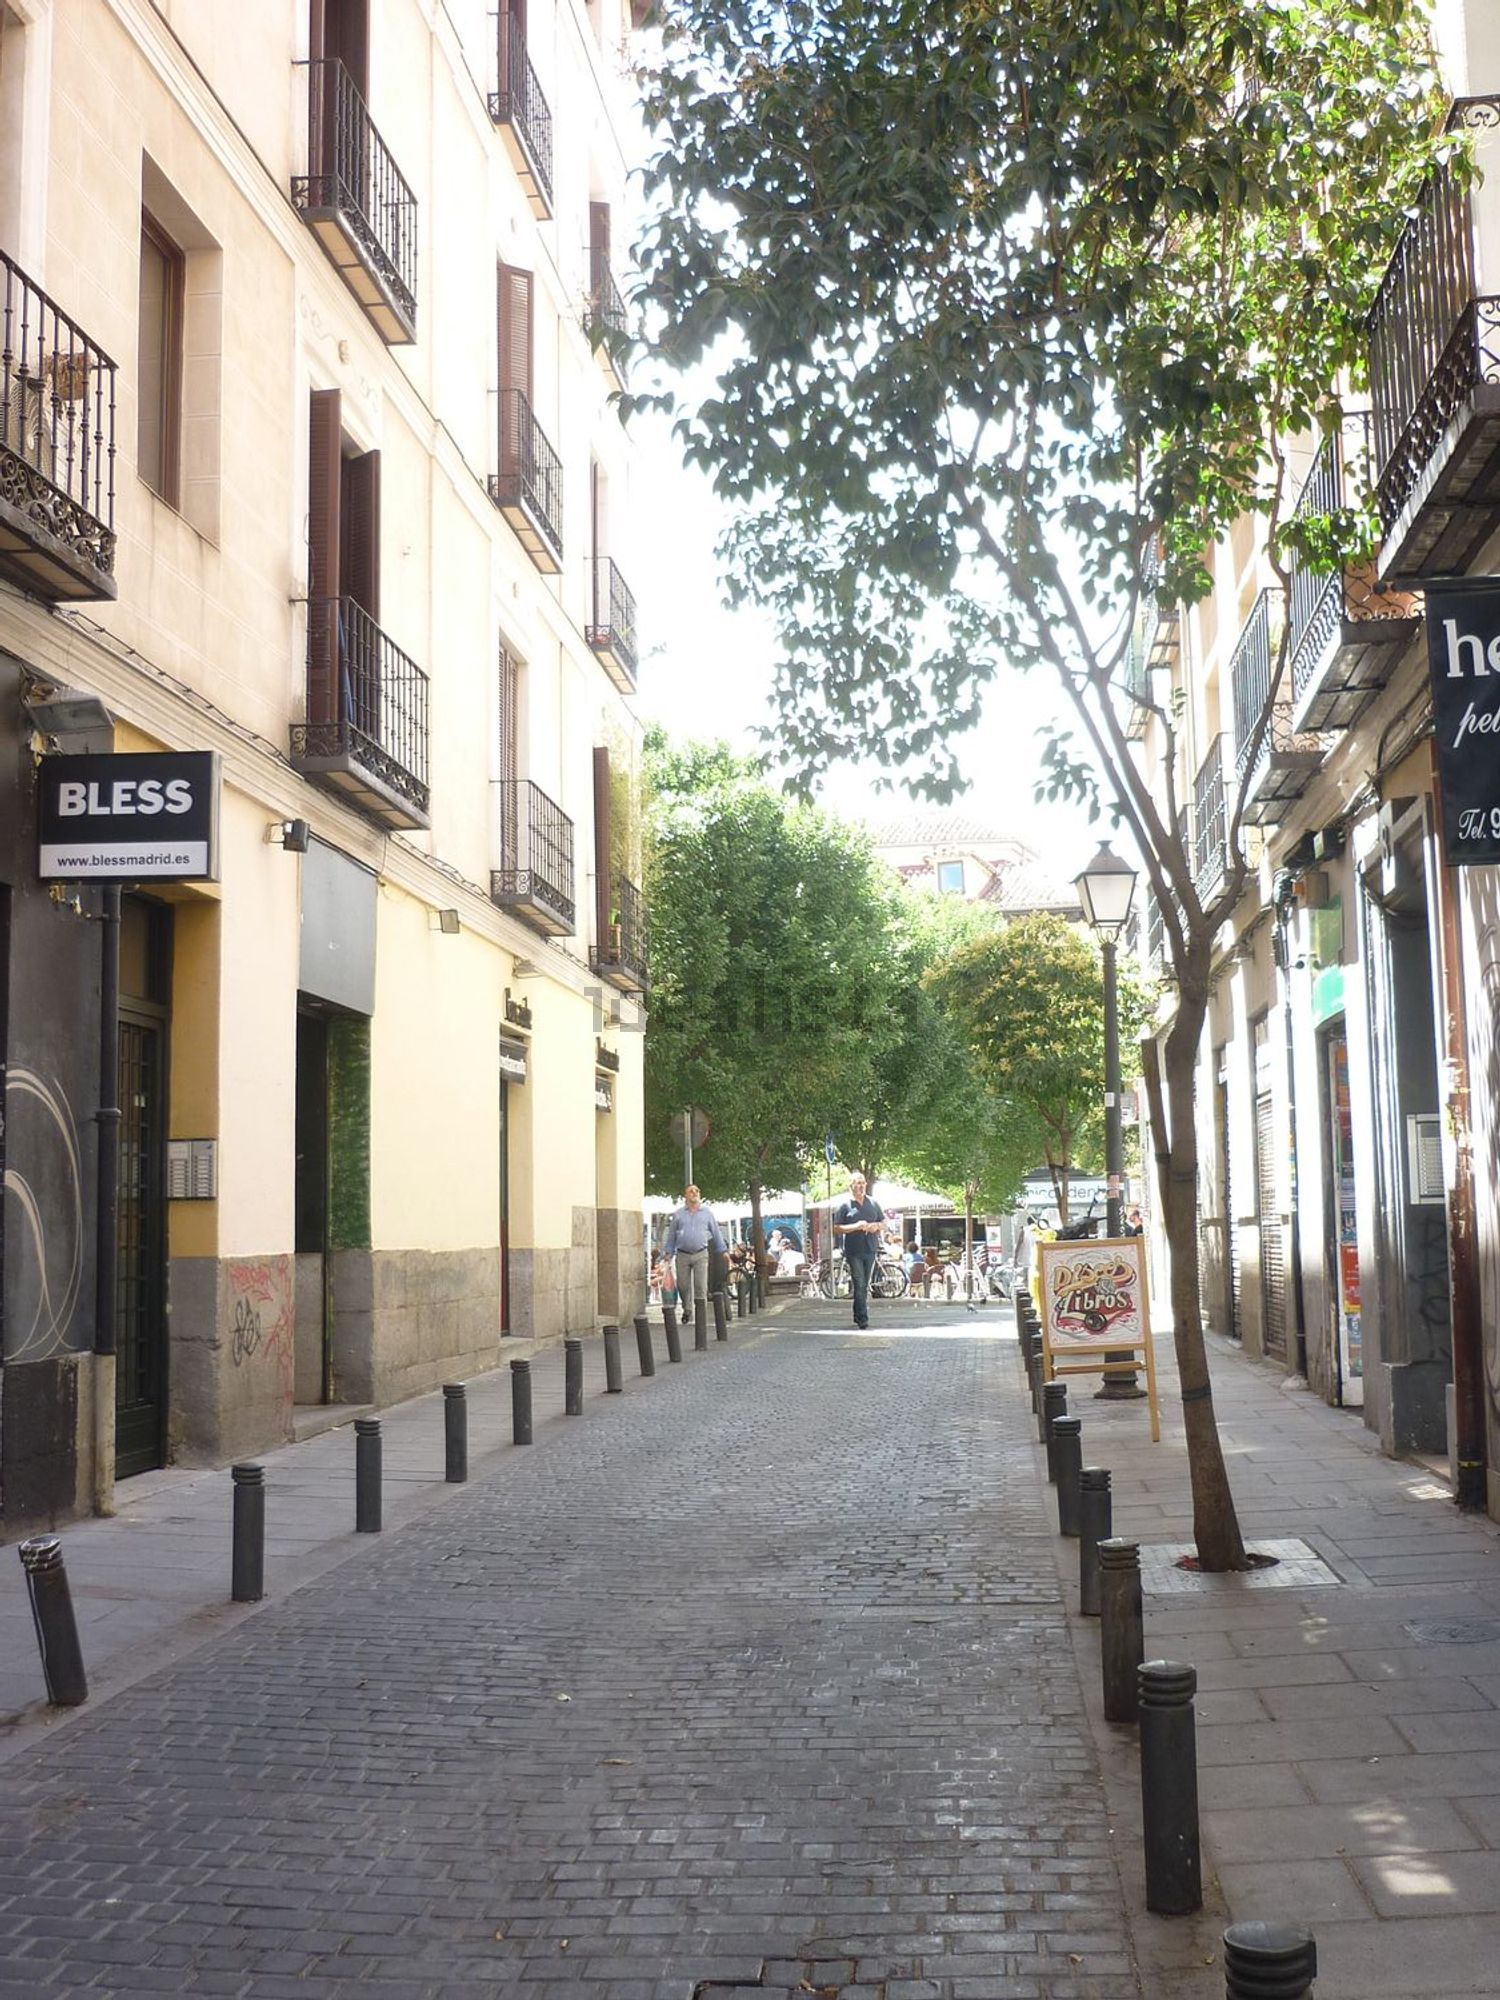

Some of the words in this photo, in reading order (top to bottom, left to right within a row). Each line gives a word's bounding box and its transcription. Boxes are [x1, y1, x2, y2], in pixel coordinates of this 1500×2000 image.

[58, 779, 193, 816] BLESS
[1458, 808, 1487, 840] Tel.
[57, 852, 190, 867] www.blessmadrid.es
[1060, 1287, 1128, 1320] Libros
